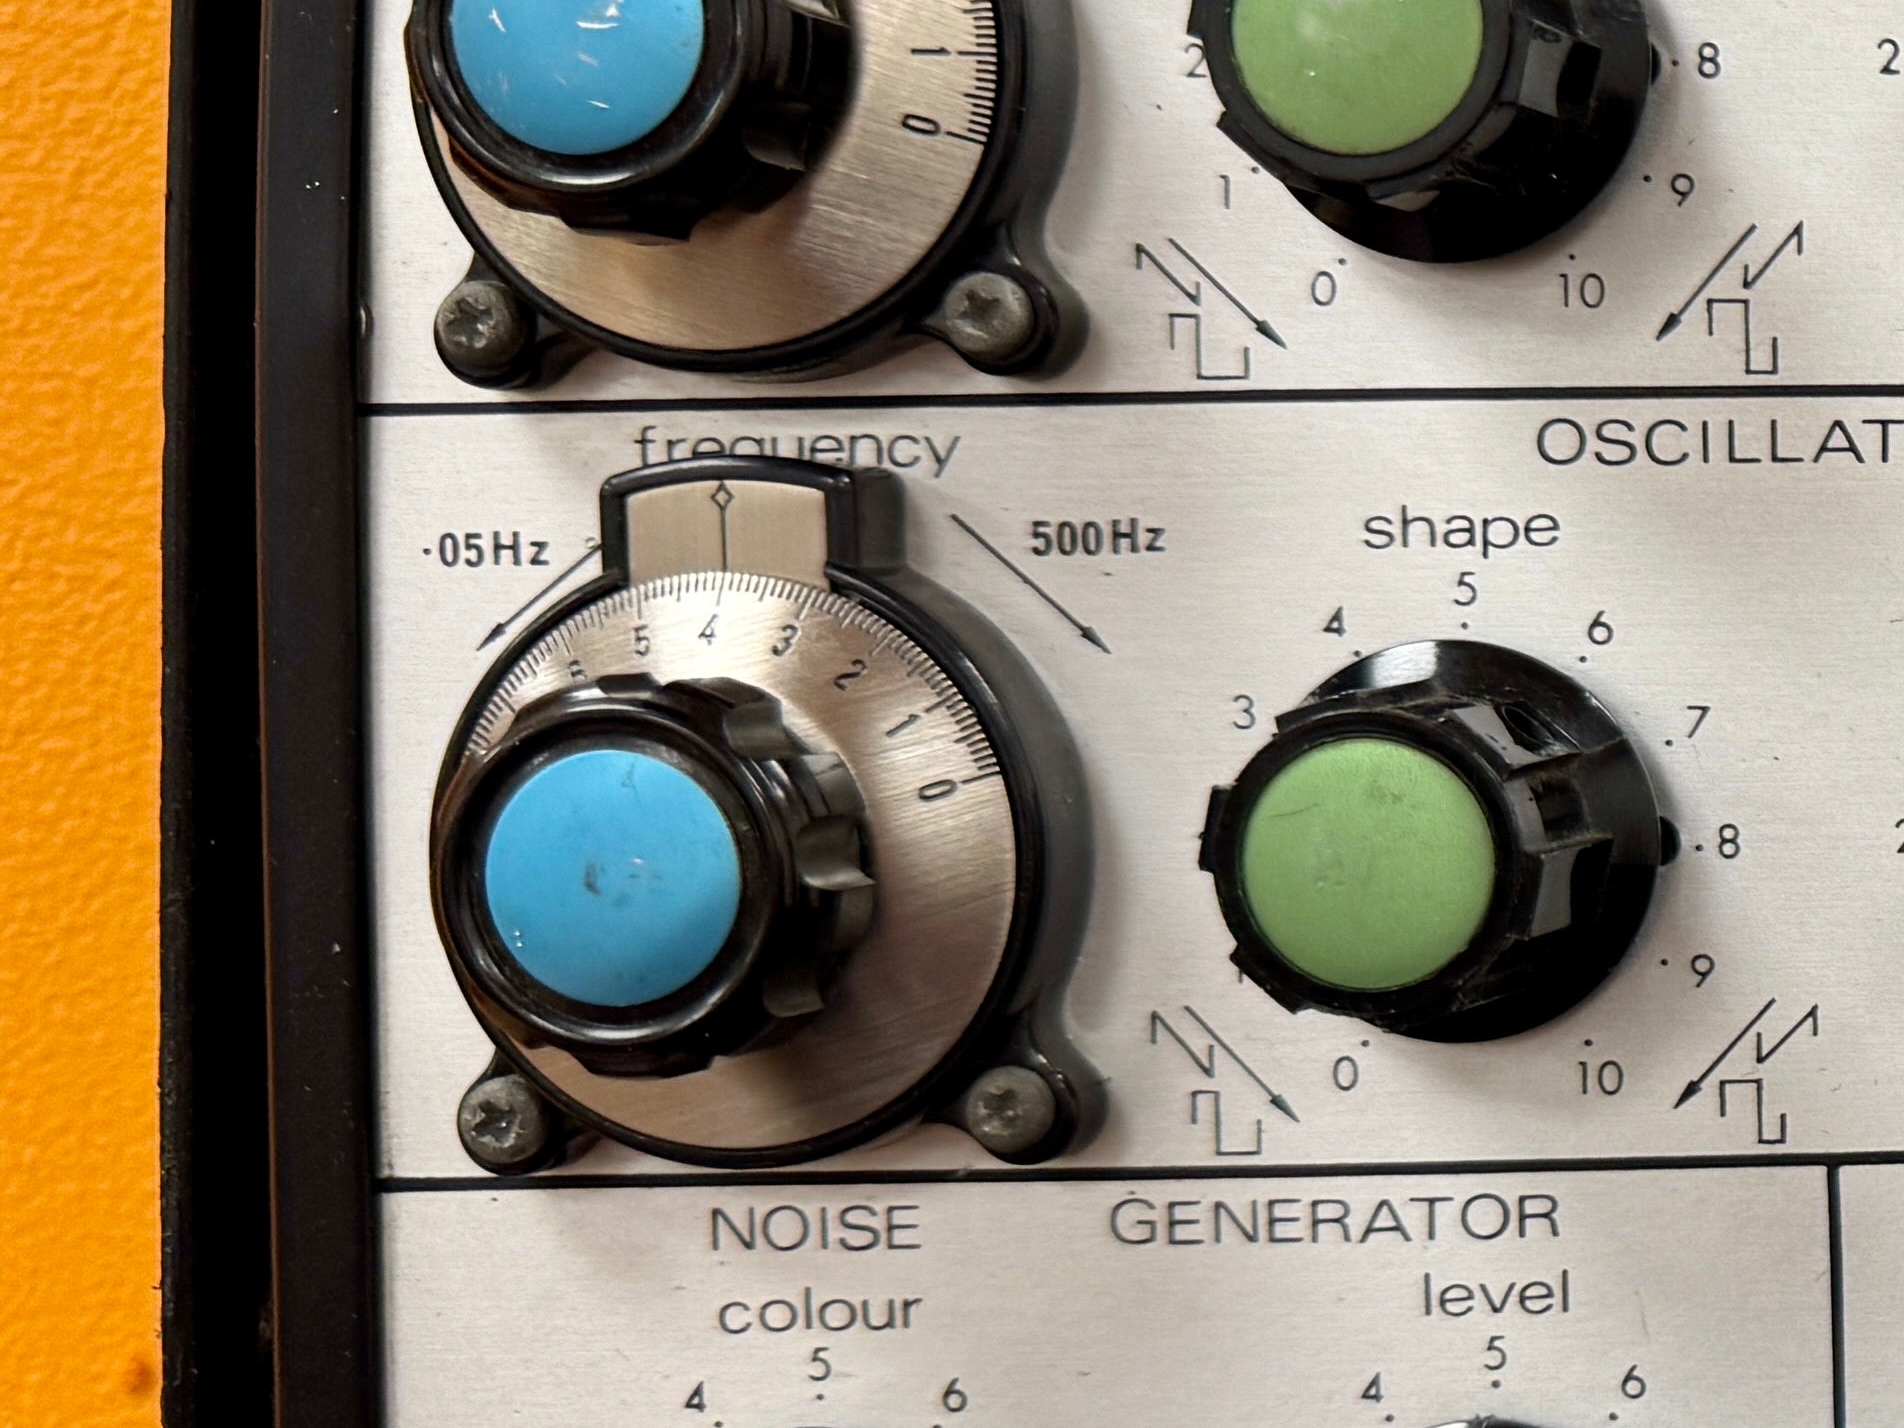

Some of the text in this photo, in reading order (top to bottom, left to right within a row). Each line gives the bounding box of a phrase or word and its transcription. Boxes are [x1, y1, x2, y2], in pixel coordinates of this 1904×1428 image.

[1362, 504, 1560, 559] shape
[711, 1193, 1559, 1252] NOISE GENERATOR
[718, 1287, 922, 1334] colour
[1424, 1269, 1569, 1317] level
